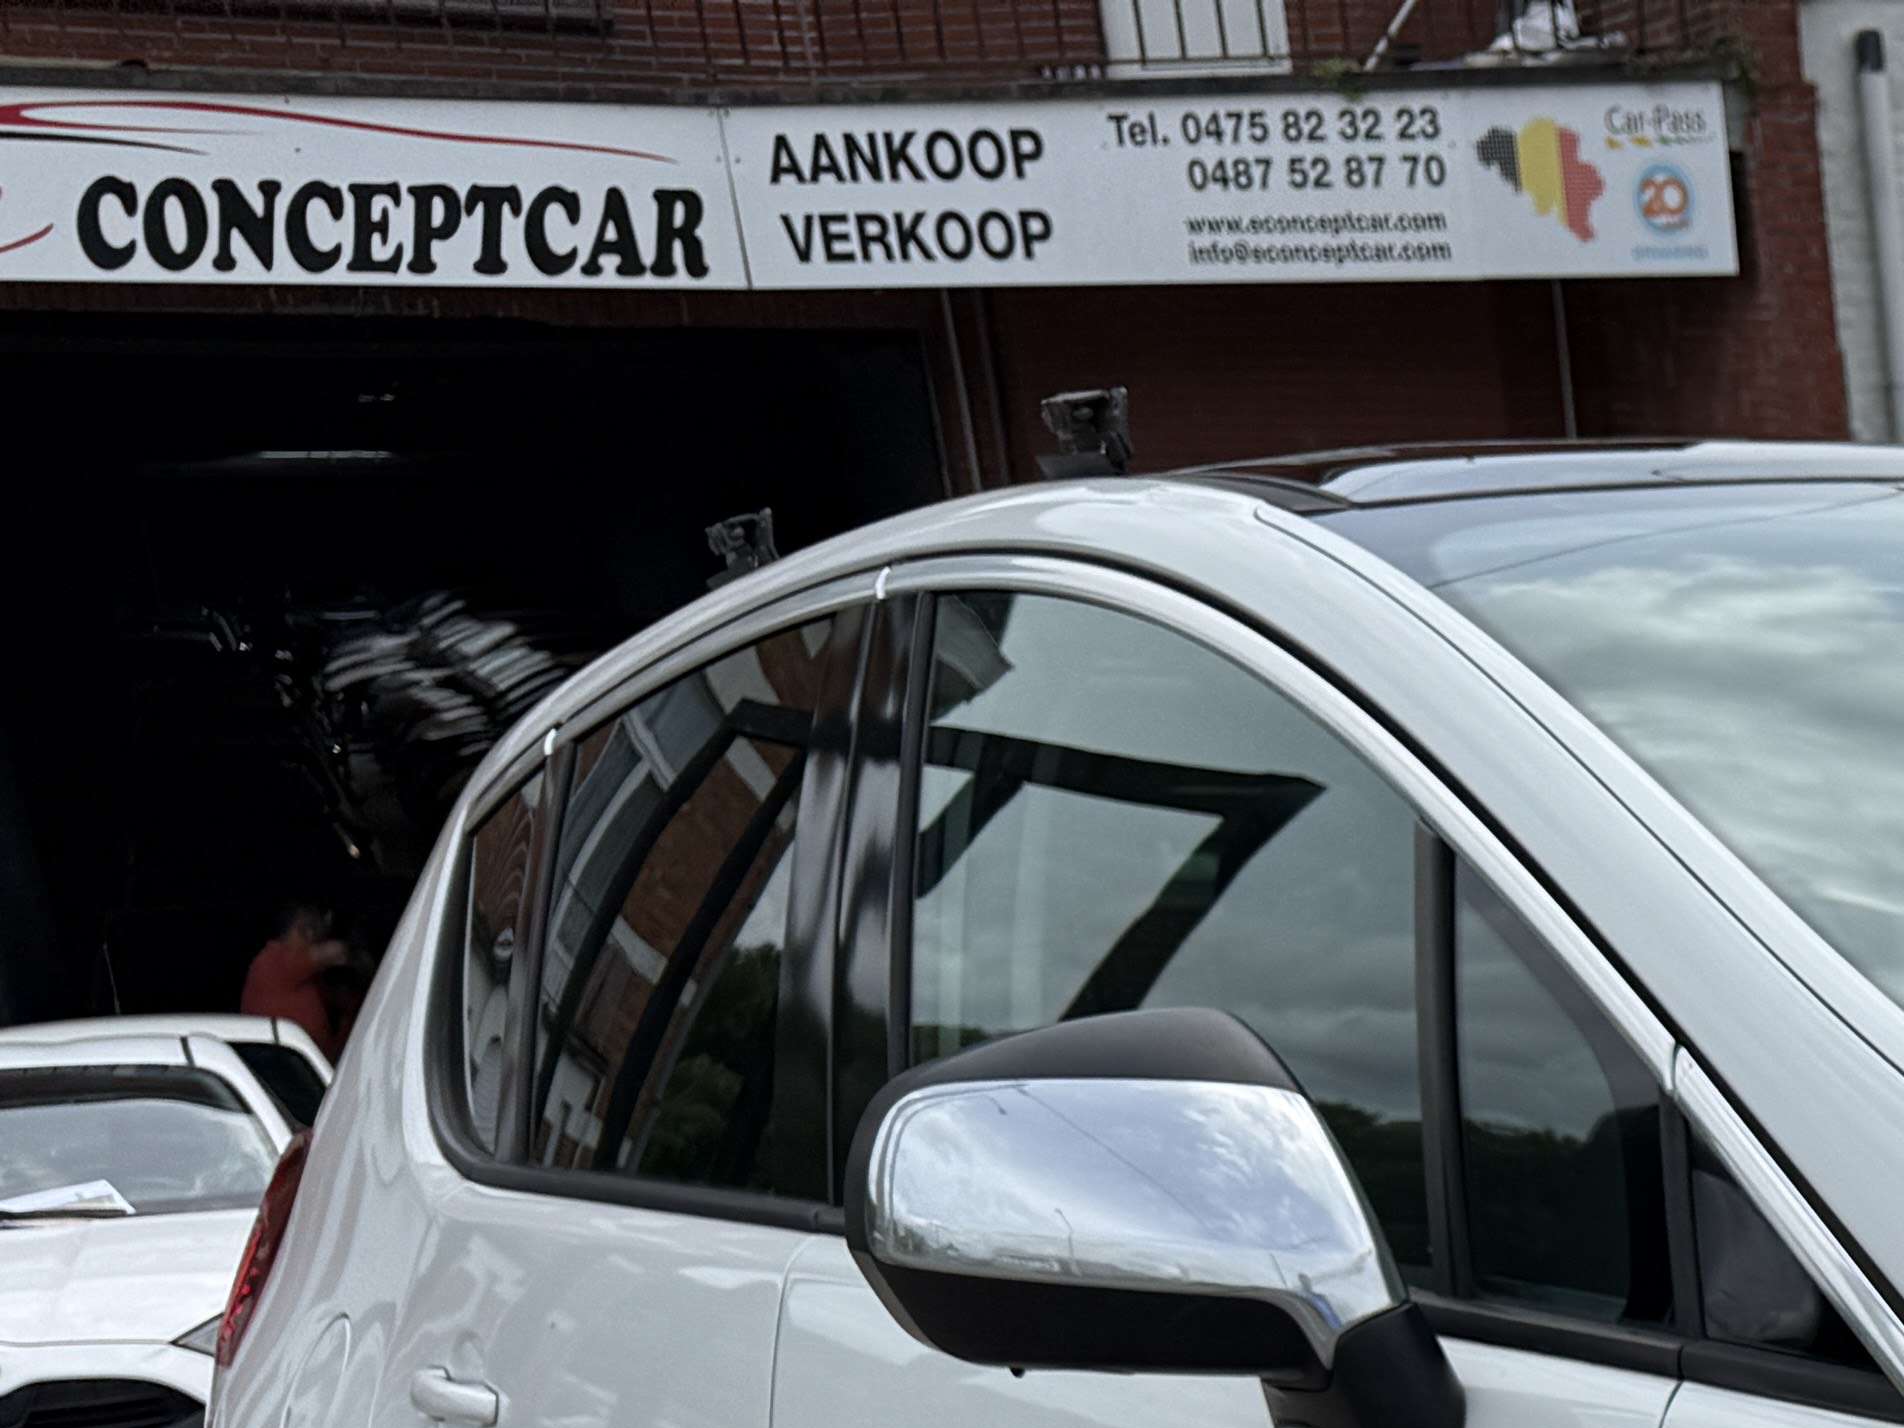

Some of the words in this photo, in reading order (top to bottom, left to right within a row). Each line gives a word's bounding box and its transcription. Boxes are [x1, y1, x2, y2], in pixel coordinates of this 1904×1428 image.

[1105, 111, 1171, 148] Tel.
[1180, 109, 1270, 146] 0475
[1281, 108, 1327, 144] 82
[1337, 106, 1385, 143] 32
[1395, 105, 1442, 142] 23
[768, 128, 1045, 186] AANKOOP
[1187, 157, 1273, 192] 0487
[1287, 156, 1334, 191] 52
[1344, 154, 1387, 189] 87
[1399, 153, 1447, 188] 70
[76, 175, 710, 280] CONCEPTCAR
[779, 208, 1054, 265] VERKOOP
